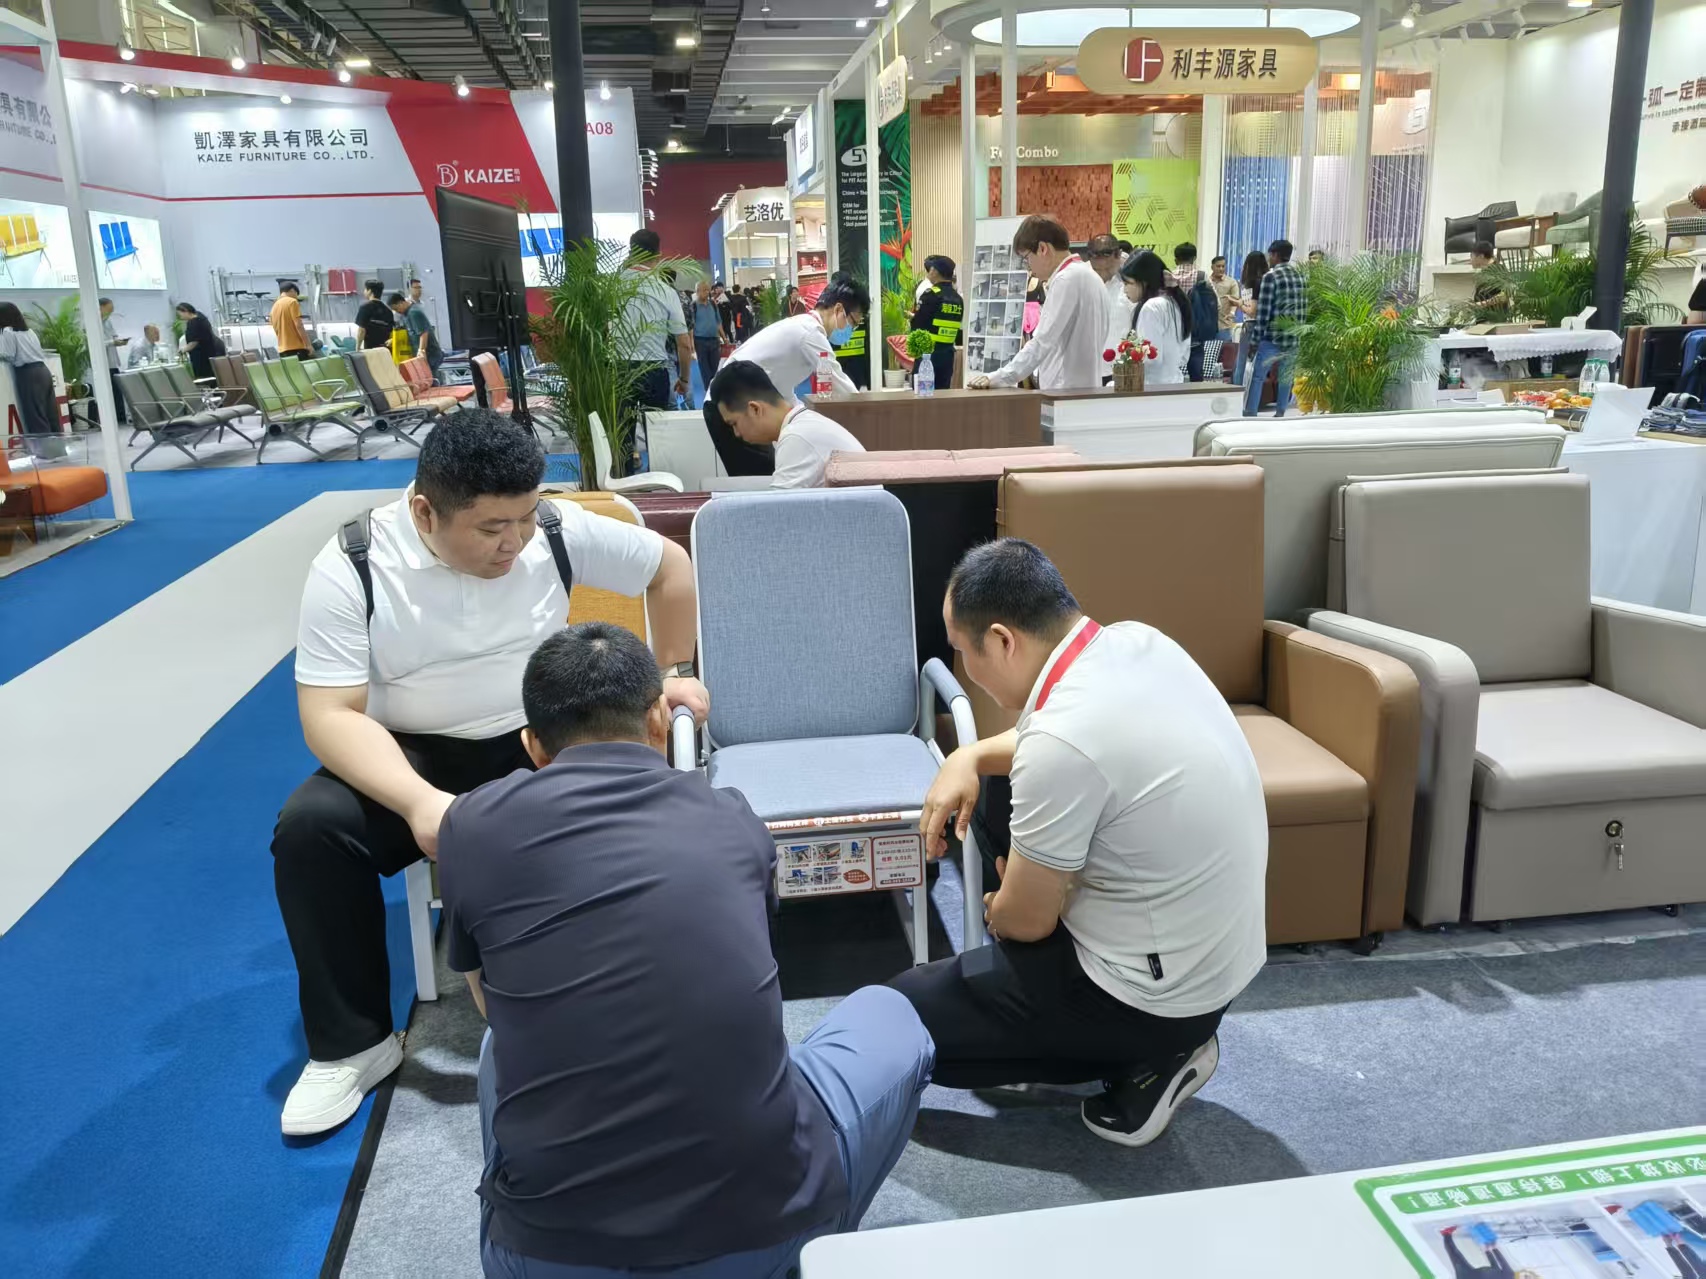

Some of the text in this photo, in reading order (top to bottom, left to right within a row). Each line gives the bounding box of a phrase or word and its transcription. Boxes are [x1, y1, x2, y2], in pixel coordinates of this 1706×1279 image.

[1170, 47, 1278, 80] 利丰源家具
[1642, 76, 1706, 108] 弧一定制
[0, 91, 52, 129] 具有限公
[194, 128, 369, 150] 凱澤家具有限公司
[197, 153, 233, 163] KAIZE
[239, 151, 307, 162] FURNITURE
[1016, 145, 1059, 159] Combo
[464, 168, 514, 184] KAIZE
[743, 201, 784, 223] 艺洛优
